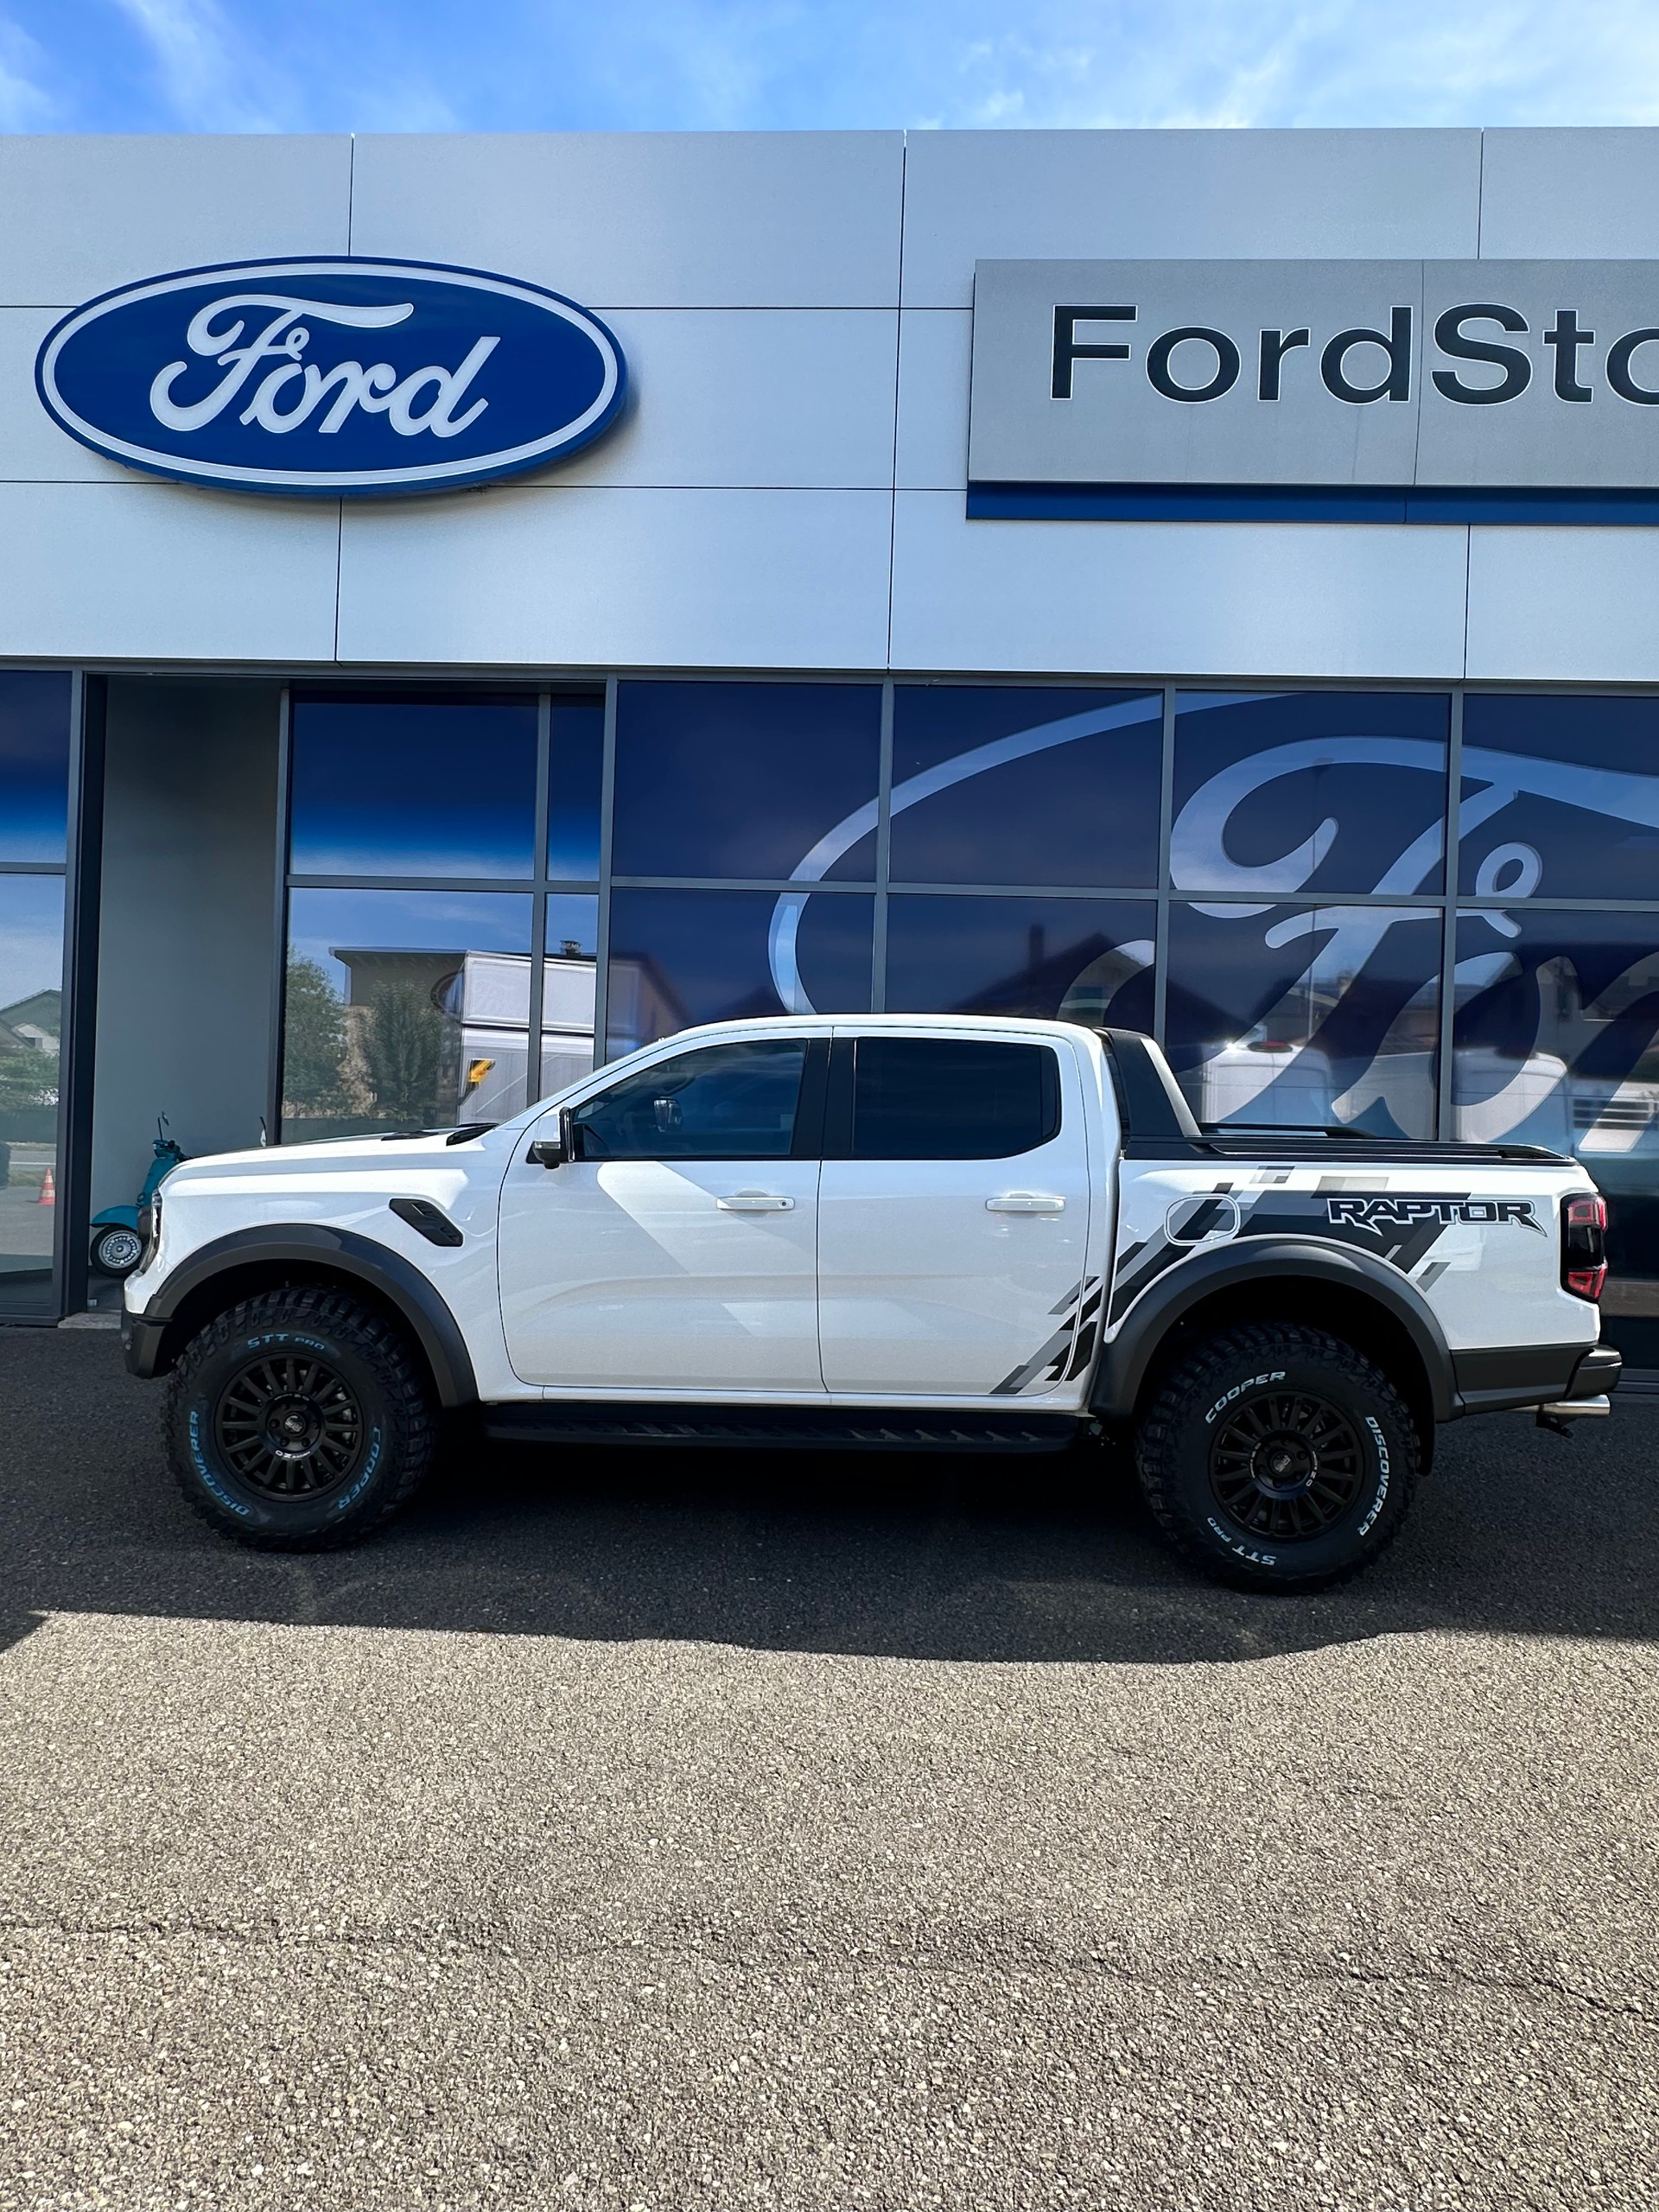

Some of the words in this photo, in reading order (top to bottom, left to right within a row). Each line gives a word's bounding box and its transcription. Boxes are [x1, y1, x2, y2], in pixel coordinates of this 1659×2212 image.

[149, 294, 501, 438] Ford
[1326, 1197, 1548, 1237] RAPTOR
[247, 1333, 289, 1350] STT
[294, 1337, 326, 1351] PRO
[1205, 1370, 1287, 1424] COOPER
[188, 1410, 251, 1516] DISCOVERER
[337, 1427, 382, 1510] COOPER
[1357, 1415, 1390, 1536] DISCOVERER
[1207, 1516, 1232, 1542] PRO
[1231, 1544, 1278, 1567] STT
